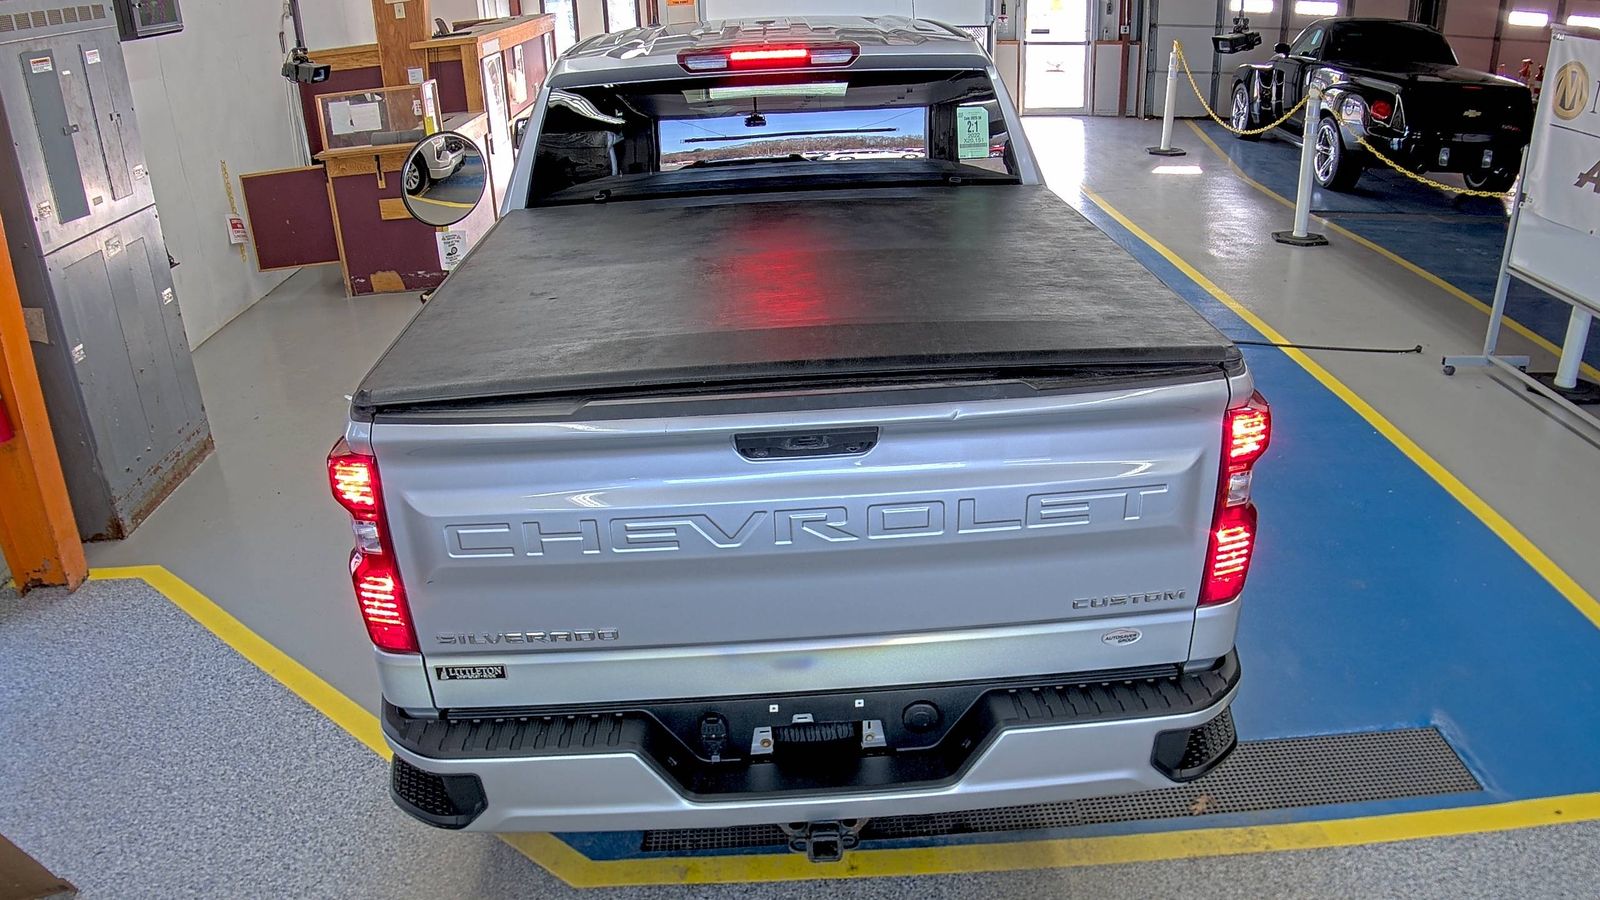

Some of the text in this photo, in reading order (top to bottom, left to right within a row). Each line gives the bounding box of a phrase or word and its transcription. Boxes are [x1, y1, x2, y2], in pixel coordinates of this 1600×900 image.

[443, 483, 1169, 558] CHEVROLET
[1072, 589, 1187, 609] CUSTOM
[436, 627, 619, 646] SILVERADO
[1104, 633, 1137, 641] AUTOSAVER
[448, 667, 502, 676] LITTLETON
